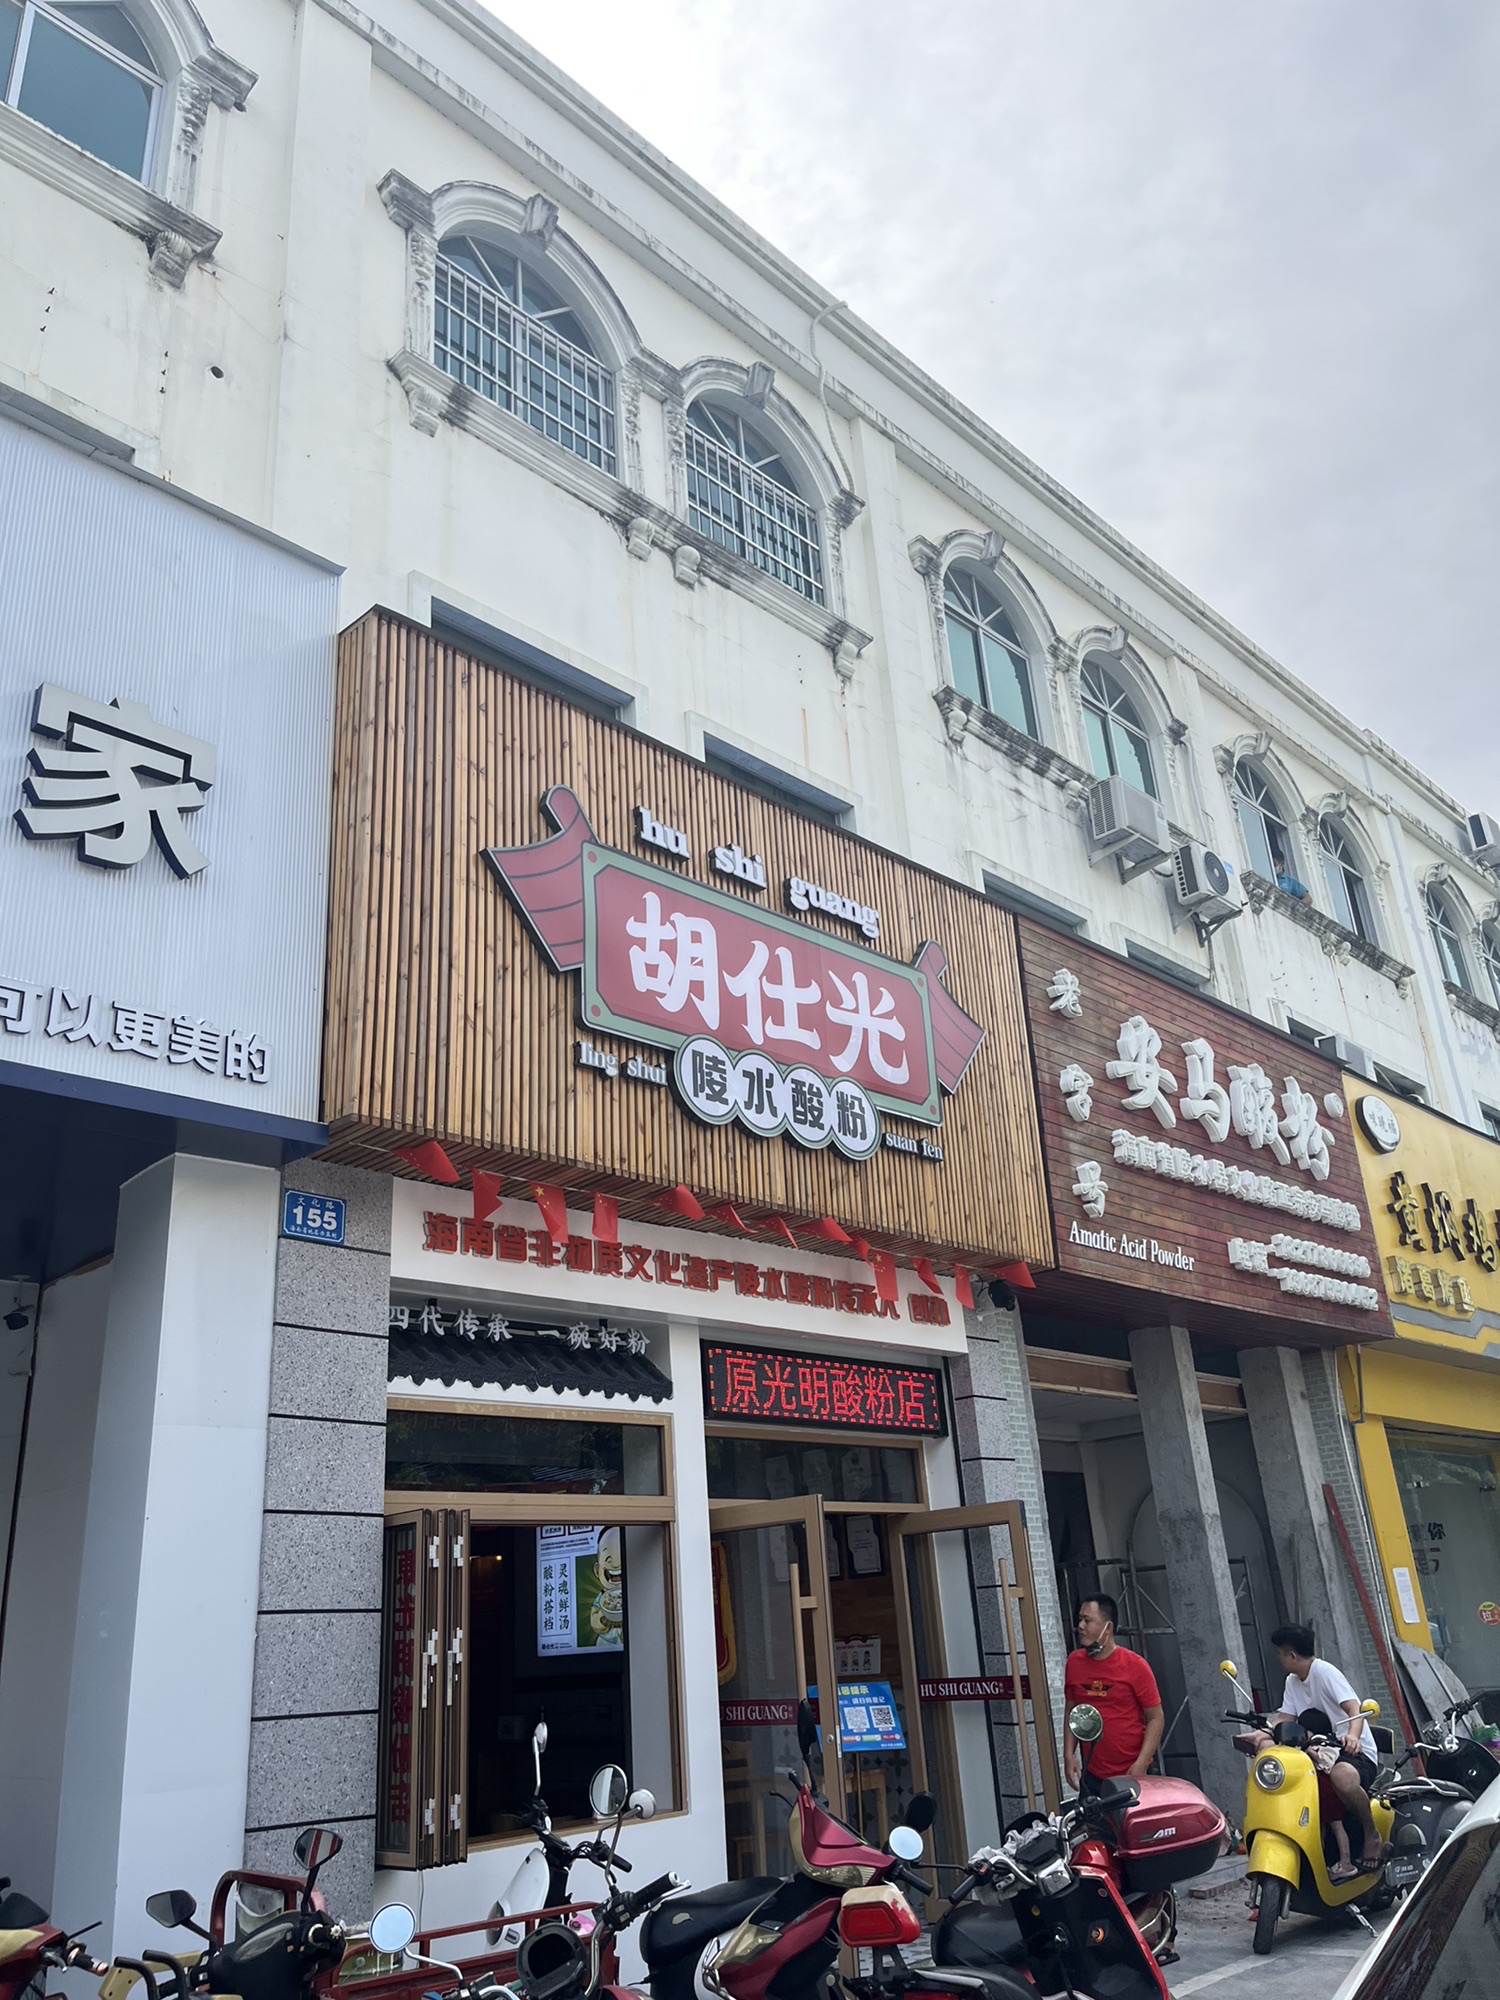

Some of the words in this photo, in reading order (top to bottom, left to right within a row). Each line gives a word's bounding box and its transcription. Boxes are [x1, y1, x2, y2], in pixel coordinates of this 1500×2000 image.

[13, 681, 217, 880] 家
[634, 805, 690, 862] hu
[709, 843, 767, 891] shi
[784, 876, 880, 940] guang
[626, 891, 910, 1085] 胡仕光
[574, 1041, 618, 1079] ling
[621, 1055, 667, 1087] shui
[692, 1050, 867, 1141] 陵水酸粉
[883, 1132, 917, 1153] suan
[922, 1137, 943, 1162] fen
[293, 1206, 337, 1231] 155
[297, 1196, 335, 1210] 文化路
[1387, 1171, 1500, 1272] 黄焖鸡
[1069, 1220, 1117, 1255] Amatic
[1119, 1234, 1147, 1262] Acid
[1150, 1240, 1195, 1271] Powder
[388, 1305, 513, 1342] 四代传承
[537, 1321, 651, 1355] 一碗好粉
[725, 1357, 928, 1423] 原光明酸粉店
[543, 1564, 554, 1631] 酸粉搭档
[558, 1563, 569, 1630] 灵魂鲜汤
[726, 1705, 745, 1720] SHI
[748, 1704, 787, 1720] GUANG
[838, 1685, 869, 1695] 馨提示
[920, 1684, 937, 1697] HU
[938, 1682, 957, 1696] SHI
[959, 1681, 999, 1695] GUANG
